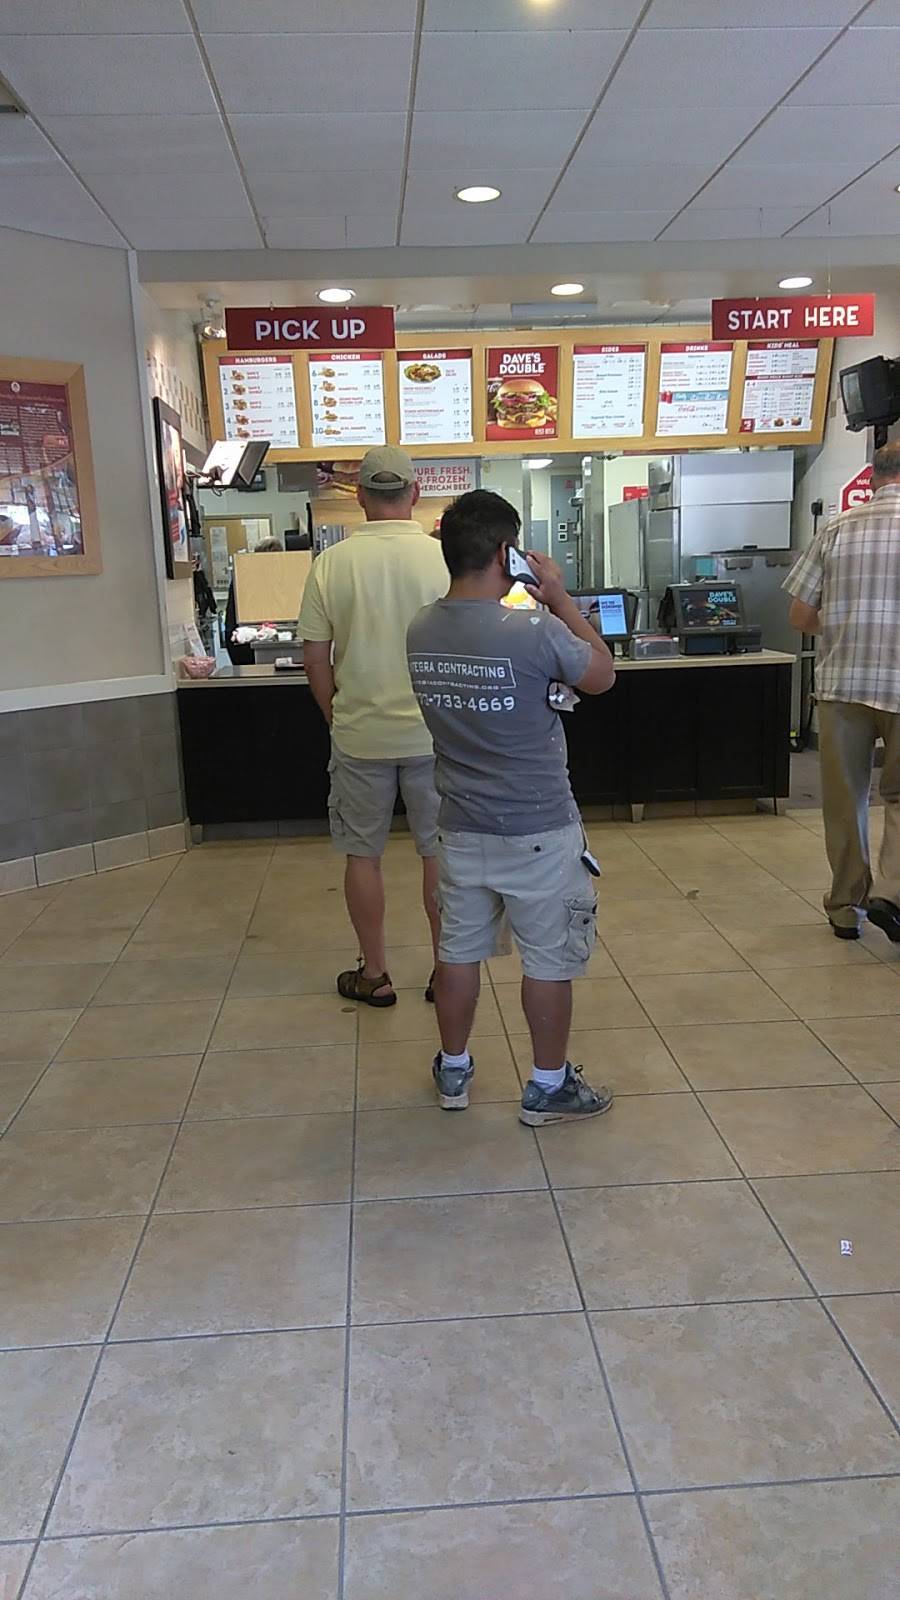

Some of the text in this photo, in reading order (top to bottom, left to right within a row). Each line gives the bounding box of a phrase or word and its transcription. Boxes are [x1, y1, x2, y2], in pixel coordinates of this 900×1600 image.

[727, 305, 859, 331] START HERE
[255, 319, 366, 341] PICK UP
[503, 352, 541, 364] DAVE'S
[499, 363, 544, 374] DOUBLE
[416, 475, 465, 484] R-FROZEN
[438, 662, 506, 678] CONTRACTING
